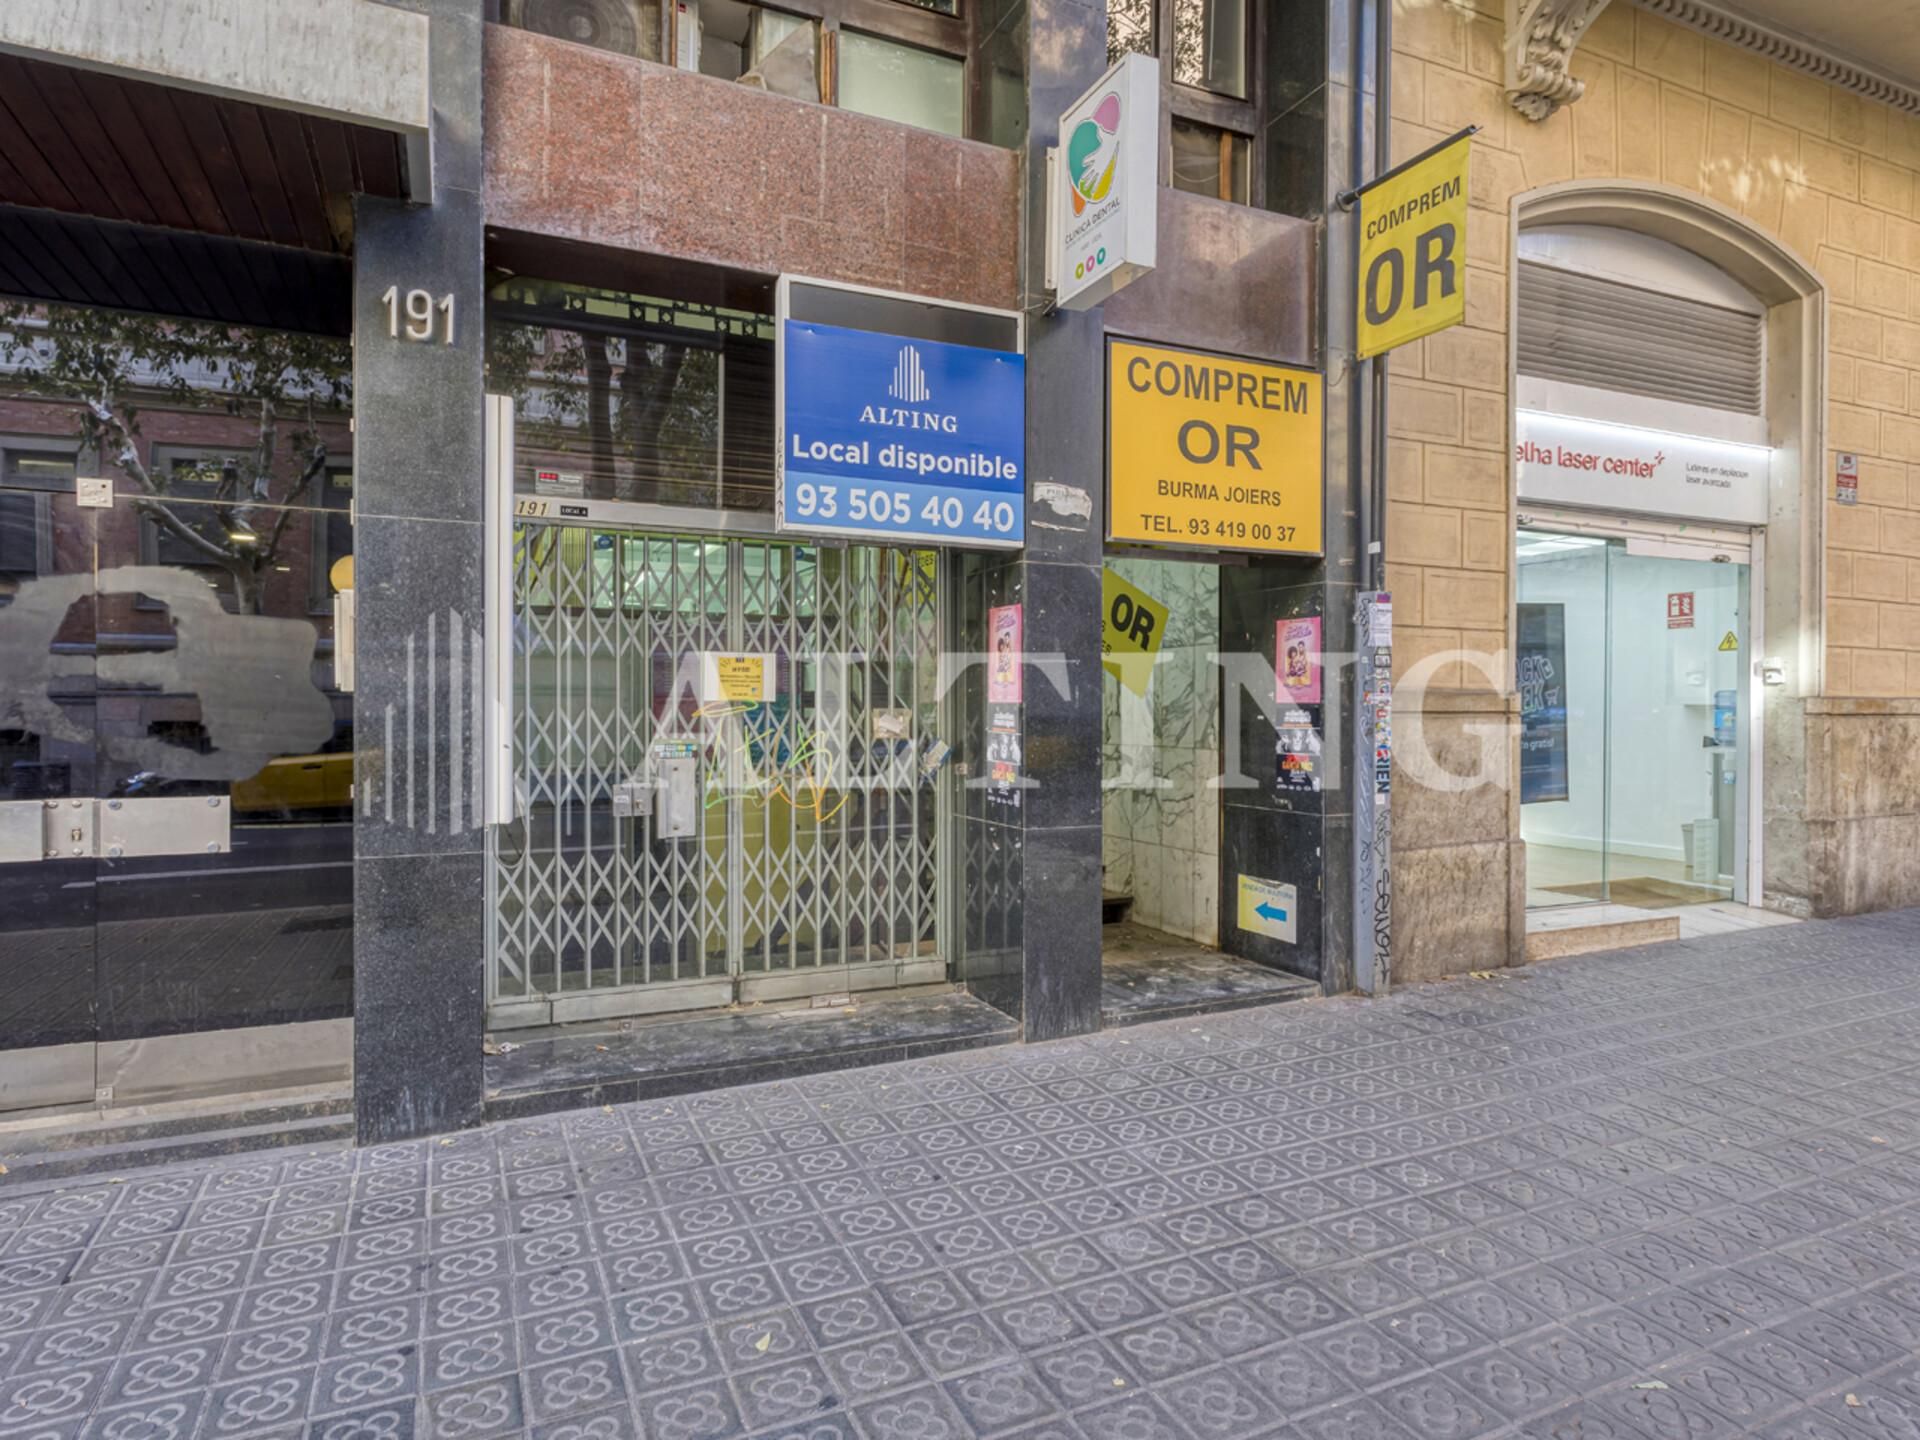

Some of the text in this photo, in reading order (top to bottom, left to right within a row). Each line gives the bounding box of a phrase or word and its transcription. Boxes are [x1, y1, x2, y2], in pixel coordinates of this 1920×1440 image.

[1366, 176, 1461, 240] COMPREM
[1365, 222, 1457, 326] OR
[382, 285, 454, 344] 191
[1127, 356, 1308, 415] COMPREM
[859, 405, 959, 433] ALTING
[792, 434, 1018, 479] Local disponible
[1177, 419, 1263, 470] OR
[1557, 446, 1600, 471] laser
[1603, 456, 1656, 479] center
[518, 501, 548, 516] 191
[796, 483, 1014, 532] 93 505 40 40
[1157, 480, 1281, 507] BURMA JOIERS
[1140, 514, 1296, 542] TEL. 93 419 00 37
[1111, 593, 1155, 652] OR
